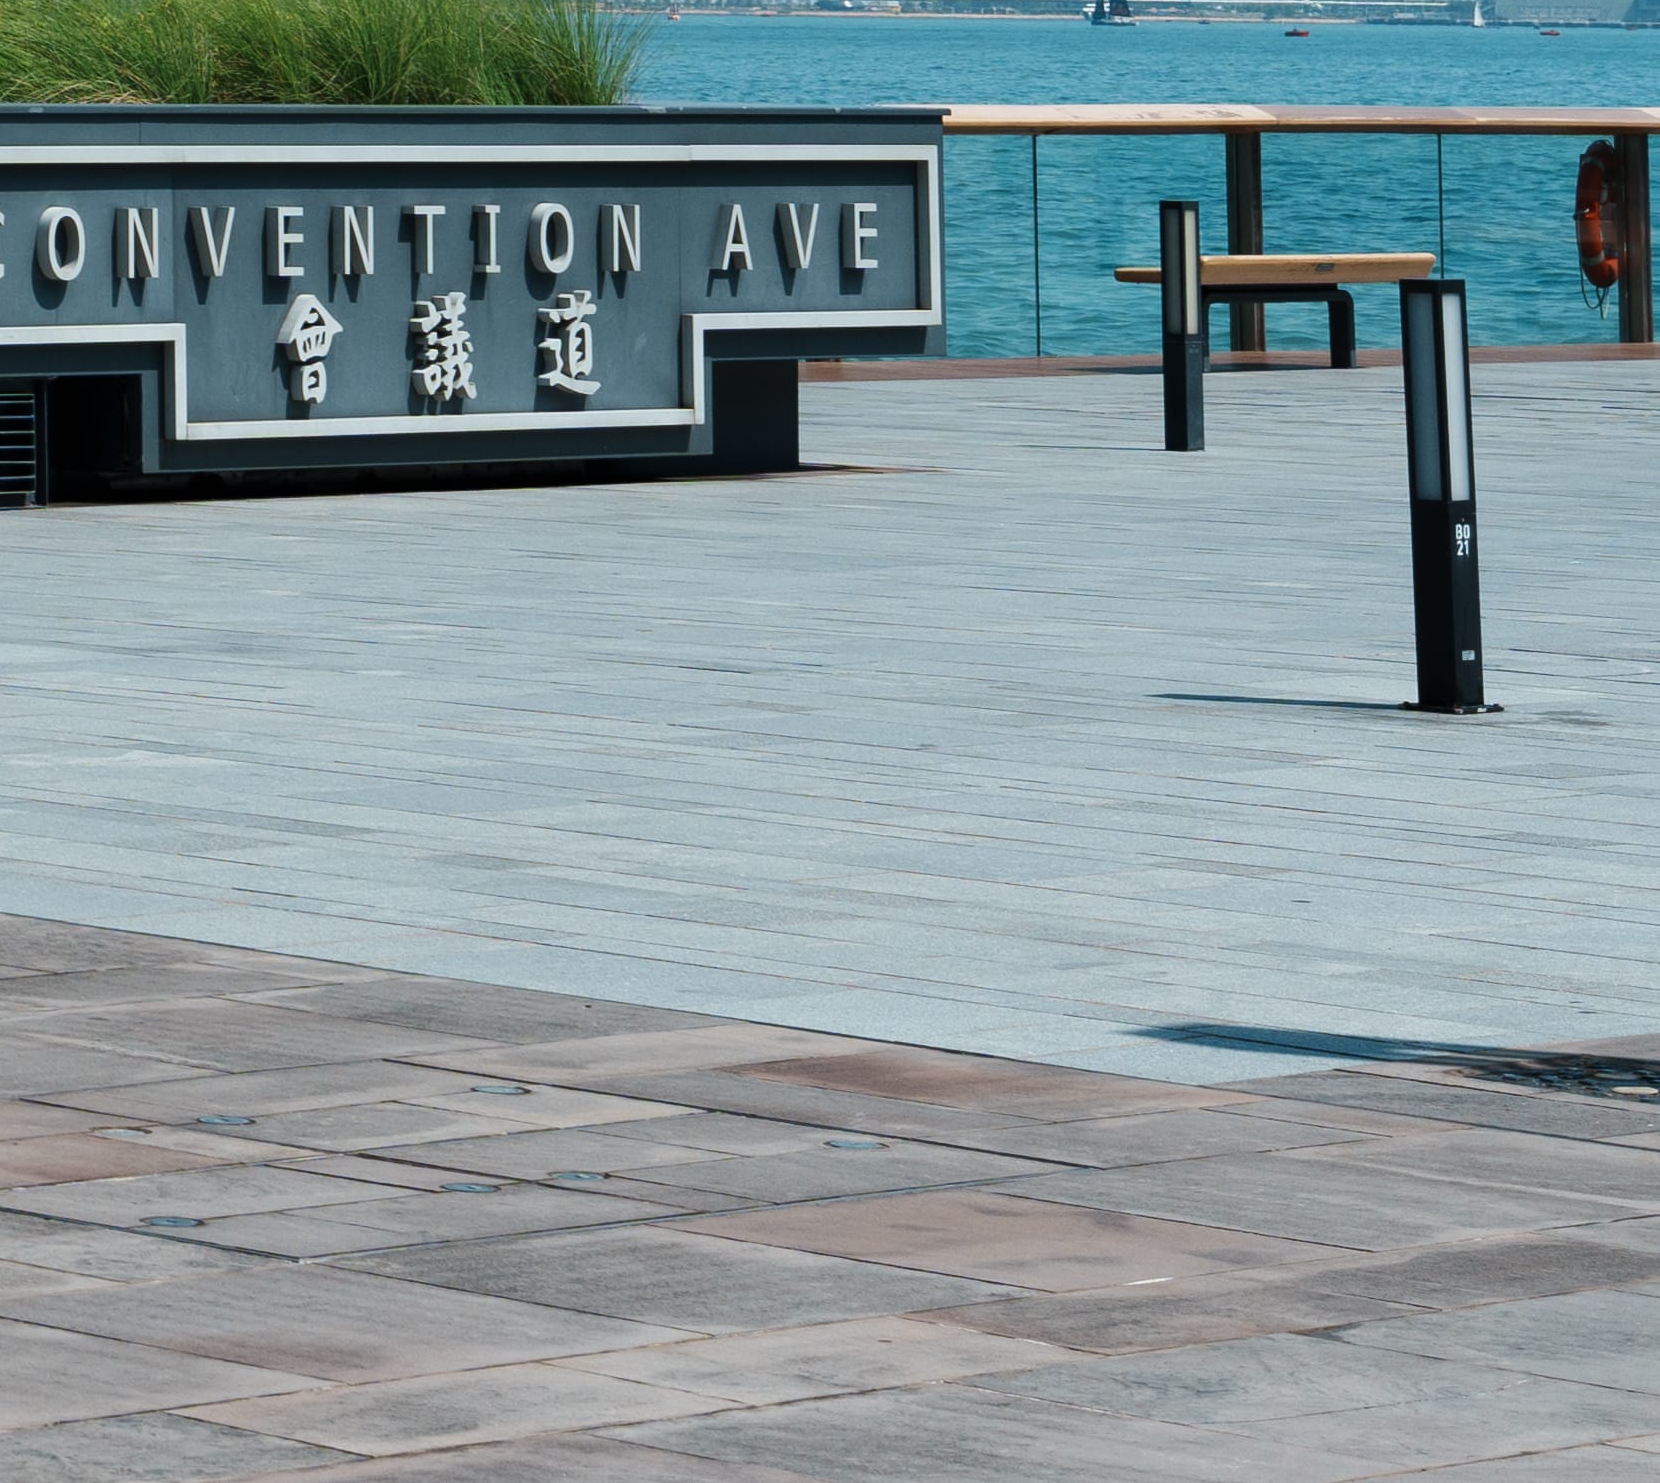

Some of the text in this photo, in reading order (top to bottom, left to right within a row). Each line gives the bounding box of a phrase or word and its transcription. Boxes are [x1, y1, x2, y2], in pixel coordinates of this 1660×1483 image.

[714, 201, 879, 271] AVE
[278, 289, 602, 405] 會議道
[1456, 540, 1470, 556] 21
